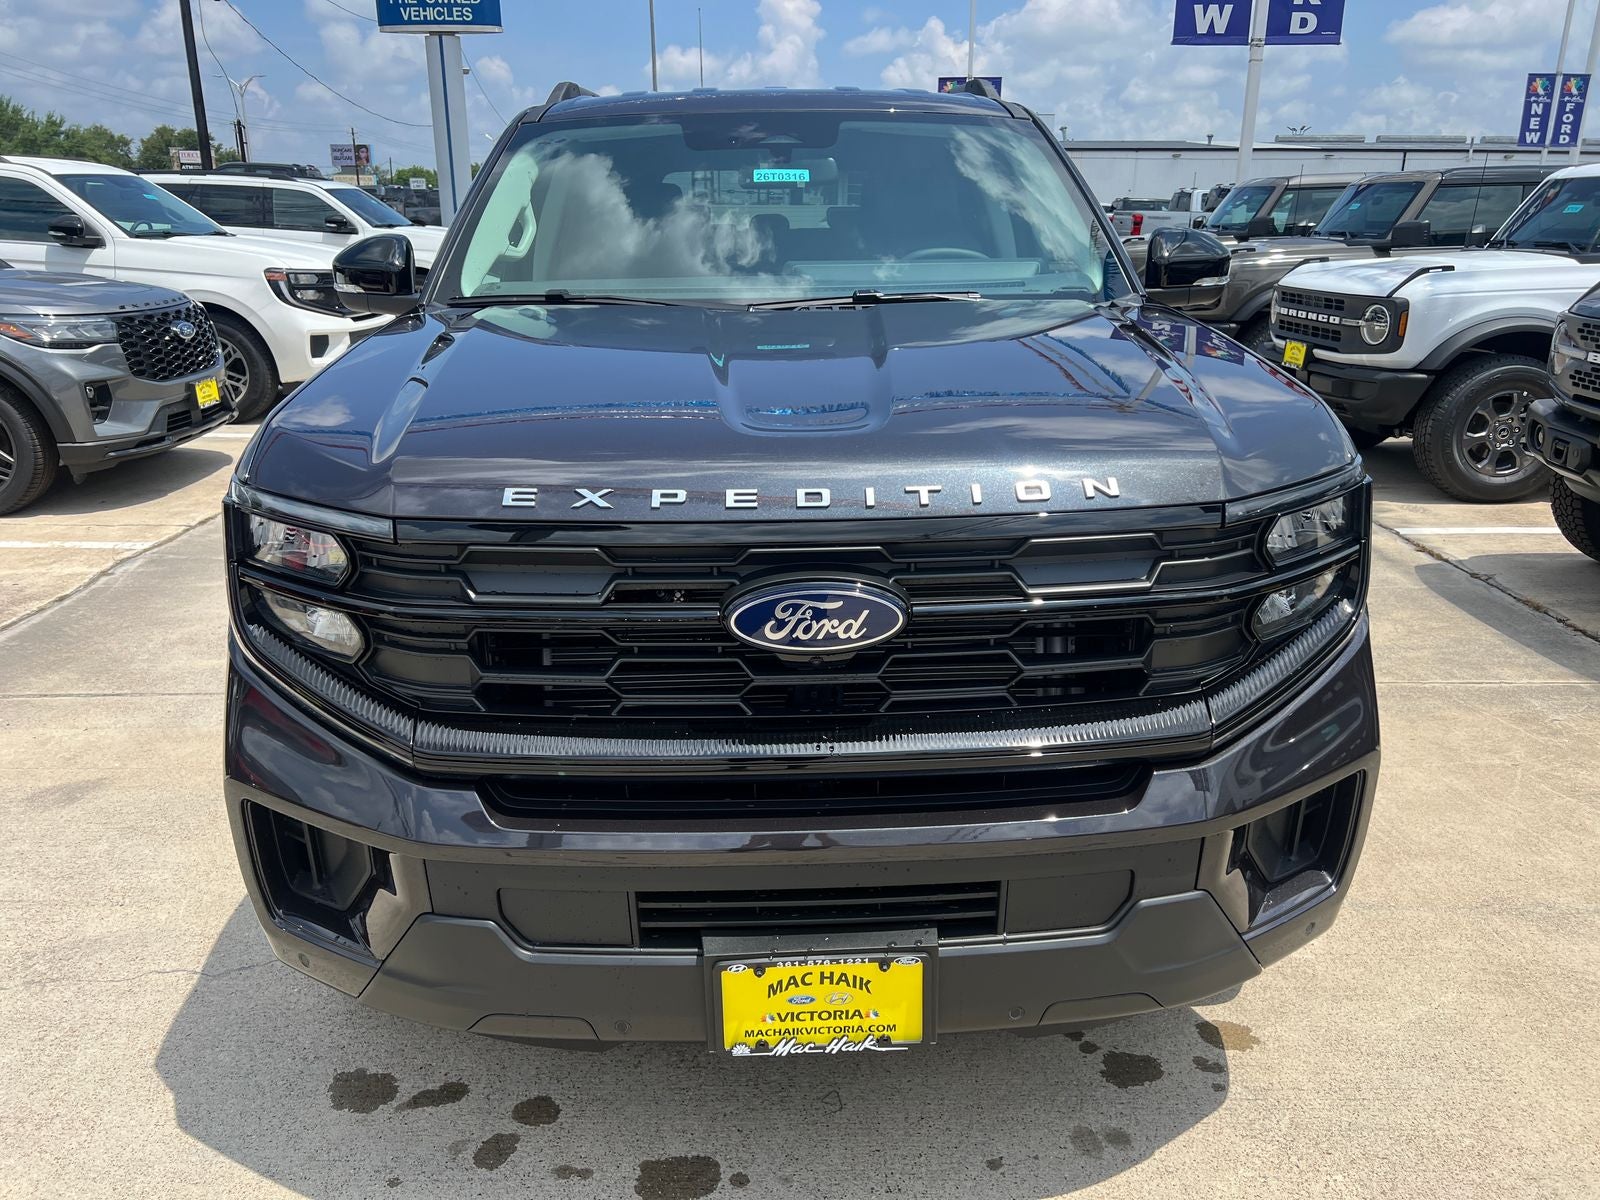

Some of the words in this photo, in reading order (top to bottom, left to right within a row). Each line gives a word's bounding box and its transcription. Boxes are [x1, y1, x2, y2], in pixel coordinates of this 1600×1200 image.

[400, 7, 473, 21] VEHICLES
[1525, 102, 1544, 144] NEW
[1558, 102, 1576, 144] FORD
[756, 172, 806, 181] 26T0316
[1280, 306, 1341, 325] BRONCO
[501, 476, 1120, 510] EXPEDITION
[764, 599, 870, 641] Ford
[767, 972, 813, 999] MAC
[819, 971, 872, 995] HAIK
[776, 1009, 865, 1023] VICTORIA
[744, 1023, 898, 1038] MACHAIKVICTORIA.COM
[770, 1037, 822, 1057] Mac
[824, 1034, 880, 1056] Haik
